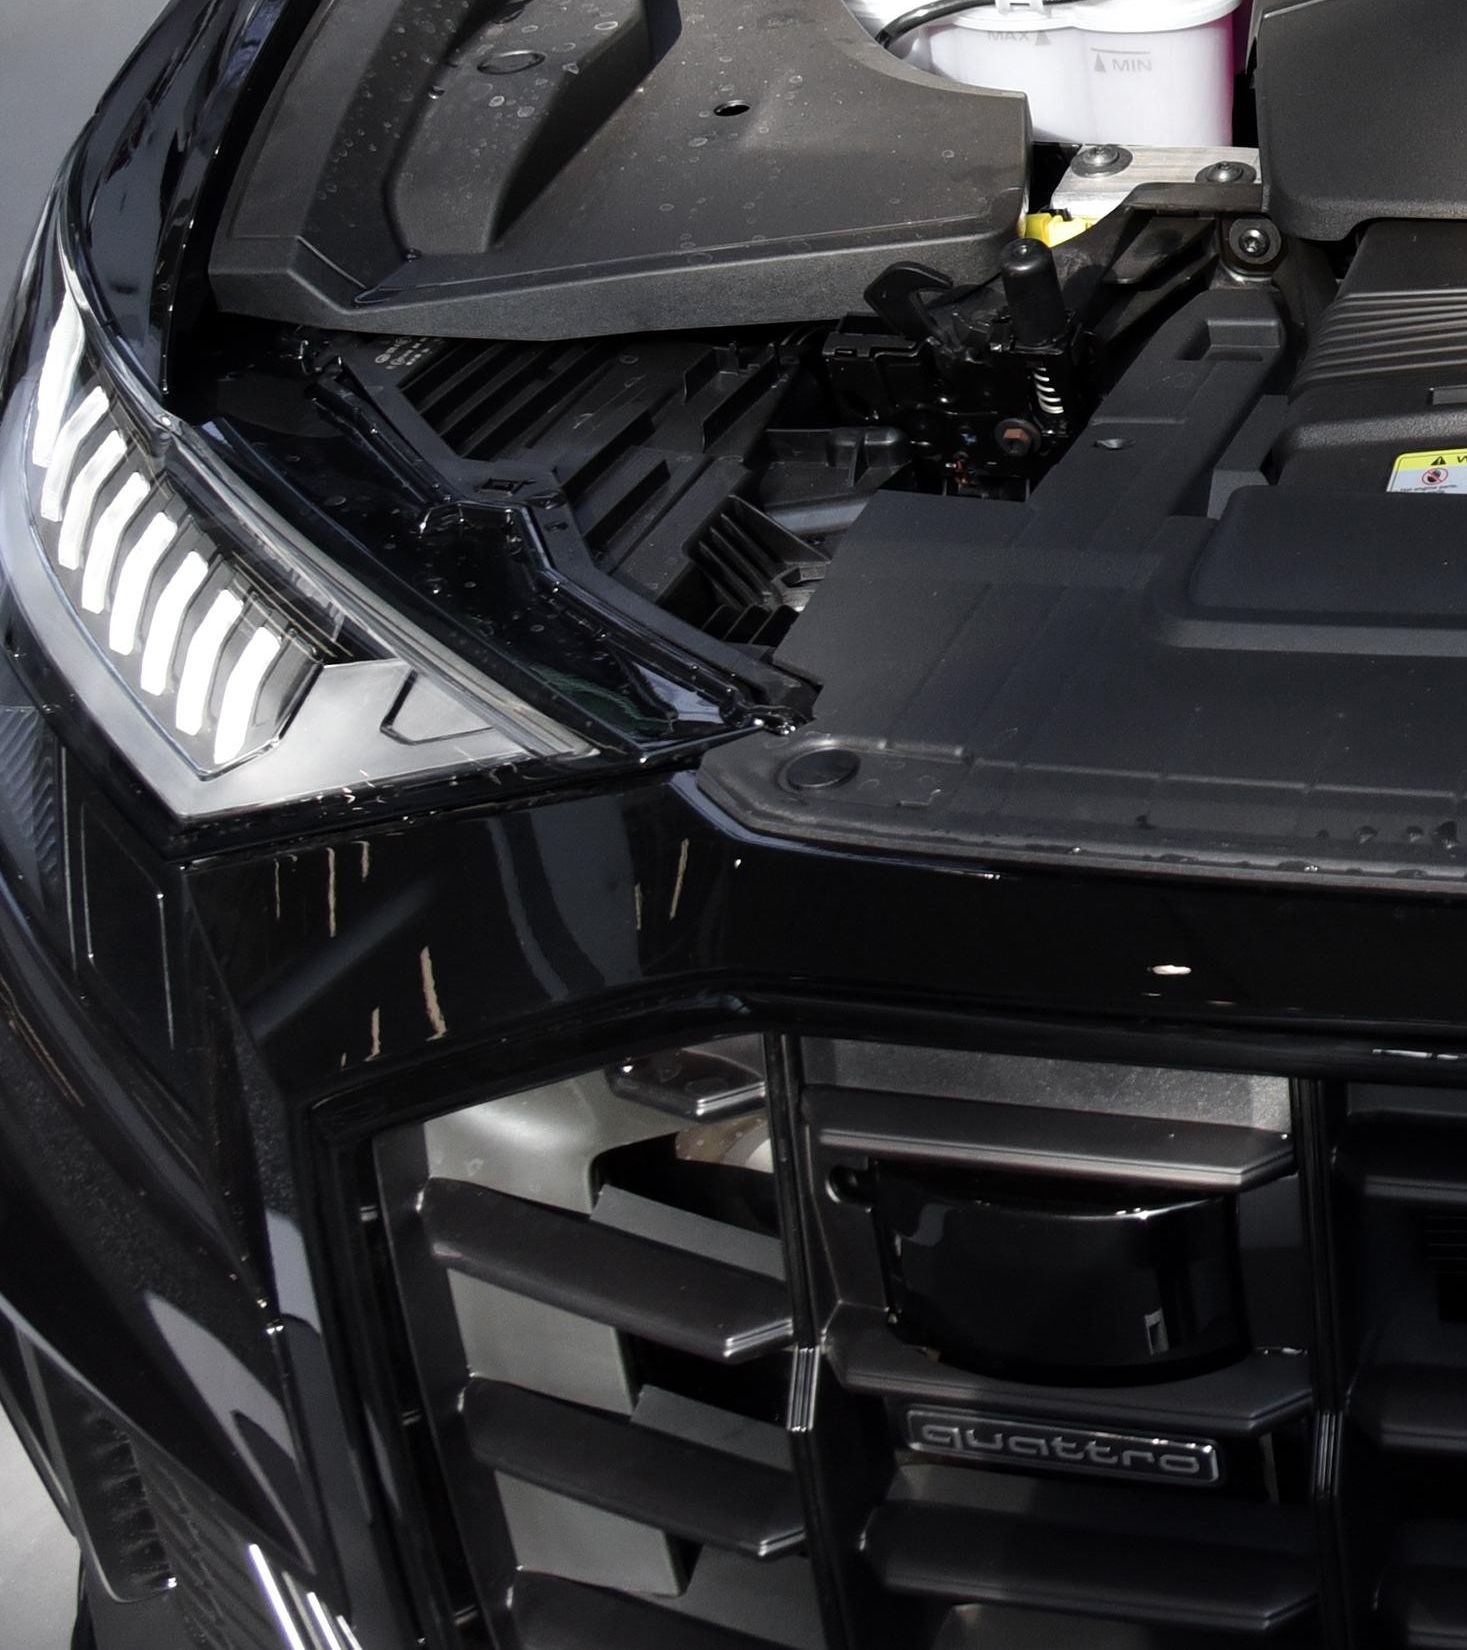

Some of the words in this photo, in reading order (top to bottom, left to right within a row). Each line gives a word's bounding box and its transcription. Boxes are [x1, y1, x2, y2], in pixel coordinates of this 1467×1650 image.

[987, 31, 1030, 43] MAX
[1111, 58, 1152, 72] MIN
[921, 1424, 1200, 1474] quattro
